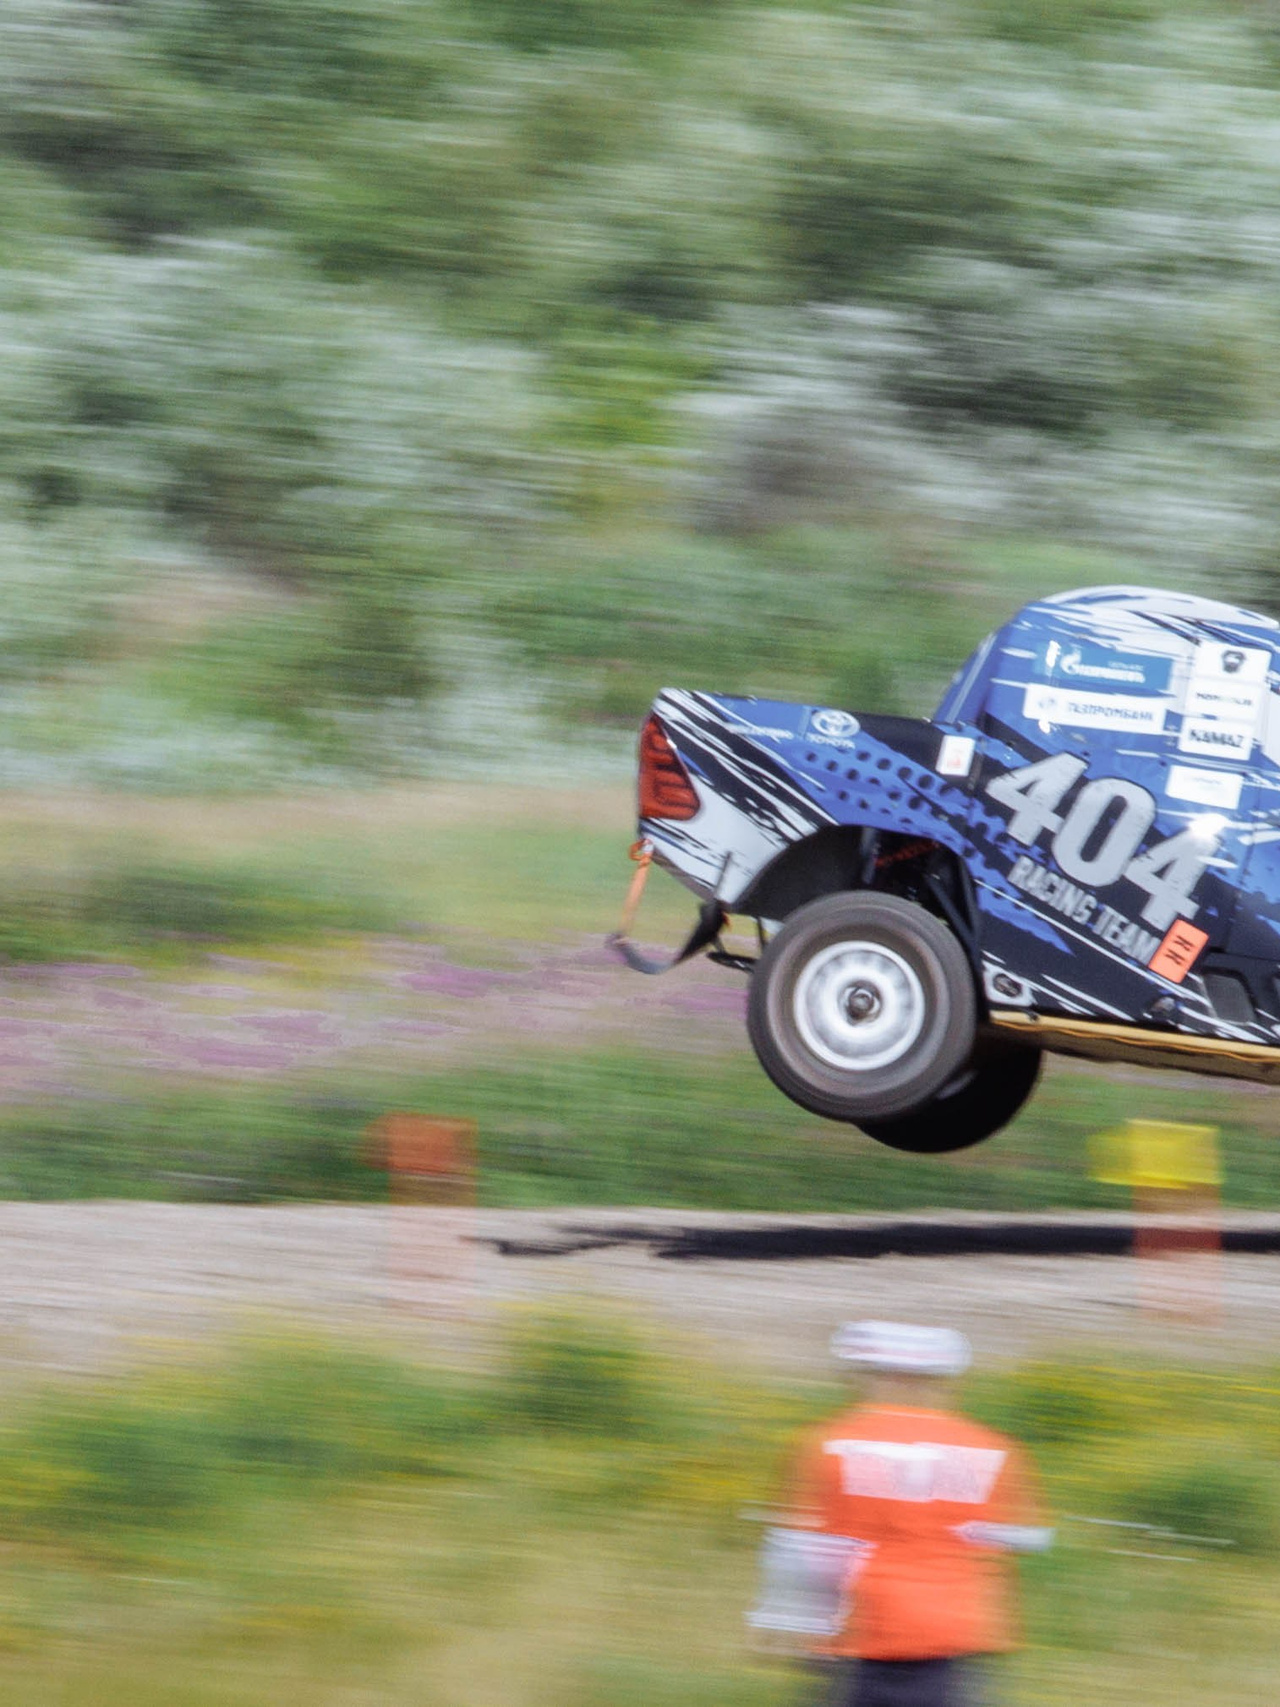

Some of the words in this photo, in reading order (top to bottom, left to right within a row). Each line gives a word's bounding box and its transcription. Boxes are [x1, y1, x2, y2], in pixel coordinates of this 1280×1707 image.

[806, 733, 856, 750] TOYOTA
[985, 752, 1222, 932] 404
[1007, 855, 1098, 925] RACING
[1093, 903, 1162, 966] TEAM
